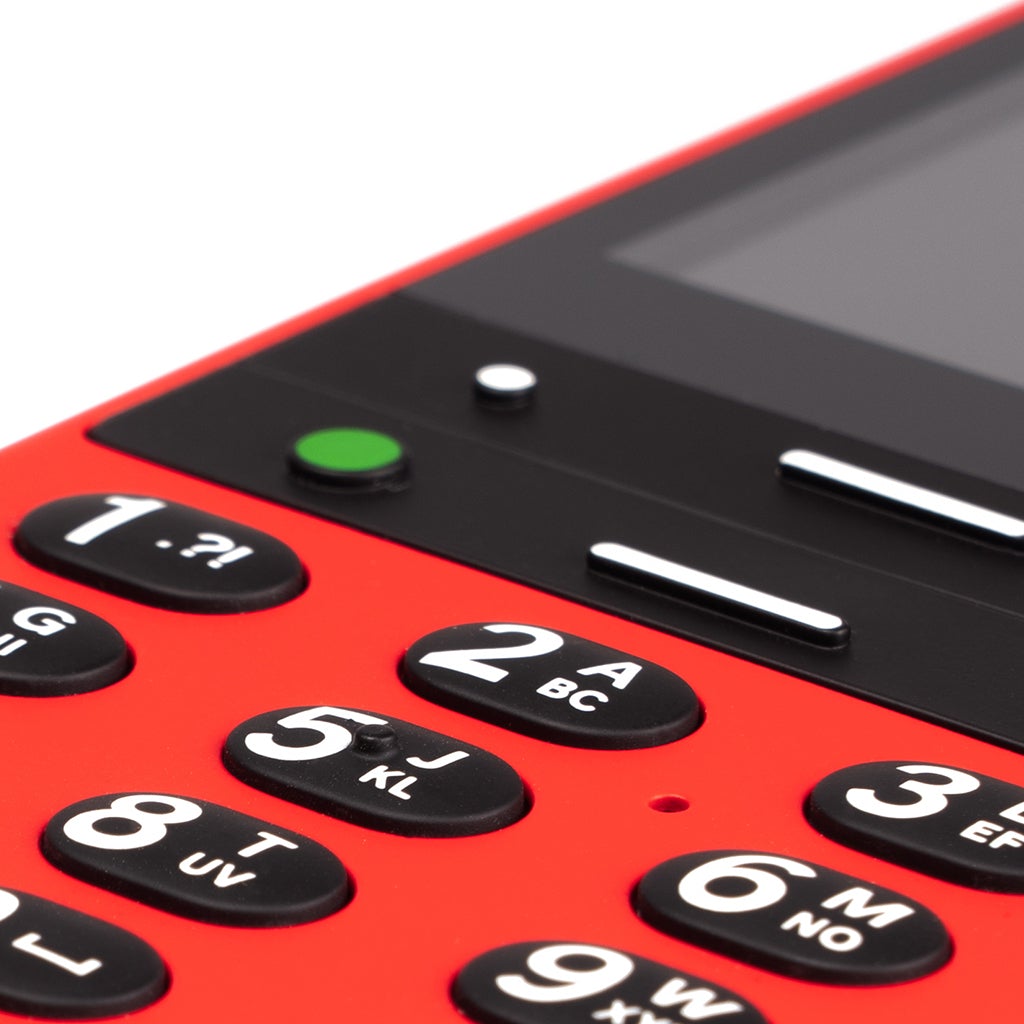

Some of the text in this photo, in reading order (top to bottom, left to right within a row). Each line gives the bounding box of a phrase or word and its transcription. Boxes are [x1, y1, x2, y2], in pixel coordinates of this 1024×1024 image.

[65, 495, 167, 546] 1
[12, 605, 77, 637] G
[418, 623, 565, 683] 2
[535, 677, 609, 712] BC
[576, 661, 643, 690] A
[244, 705, 389, 762] 5
[405, 750, 470, 770] J
[358, 764, 418, 801] KL
[845, 764, 981, 820] 3
[62, 794, 203, 851] 8
[959, 819, 1024, 849] EF
[237, 831, 299, 858] T
[178, 851, 257, 888] UV
[677, 854, 818, 913] 6
[820, 886, 916, 929] M
[780, 910, 864, 952] NO
[495, 943, 635, 1003] 9
[650, 977, 743, 1021] W
